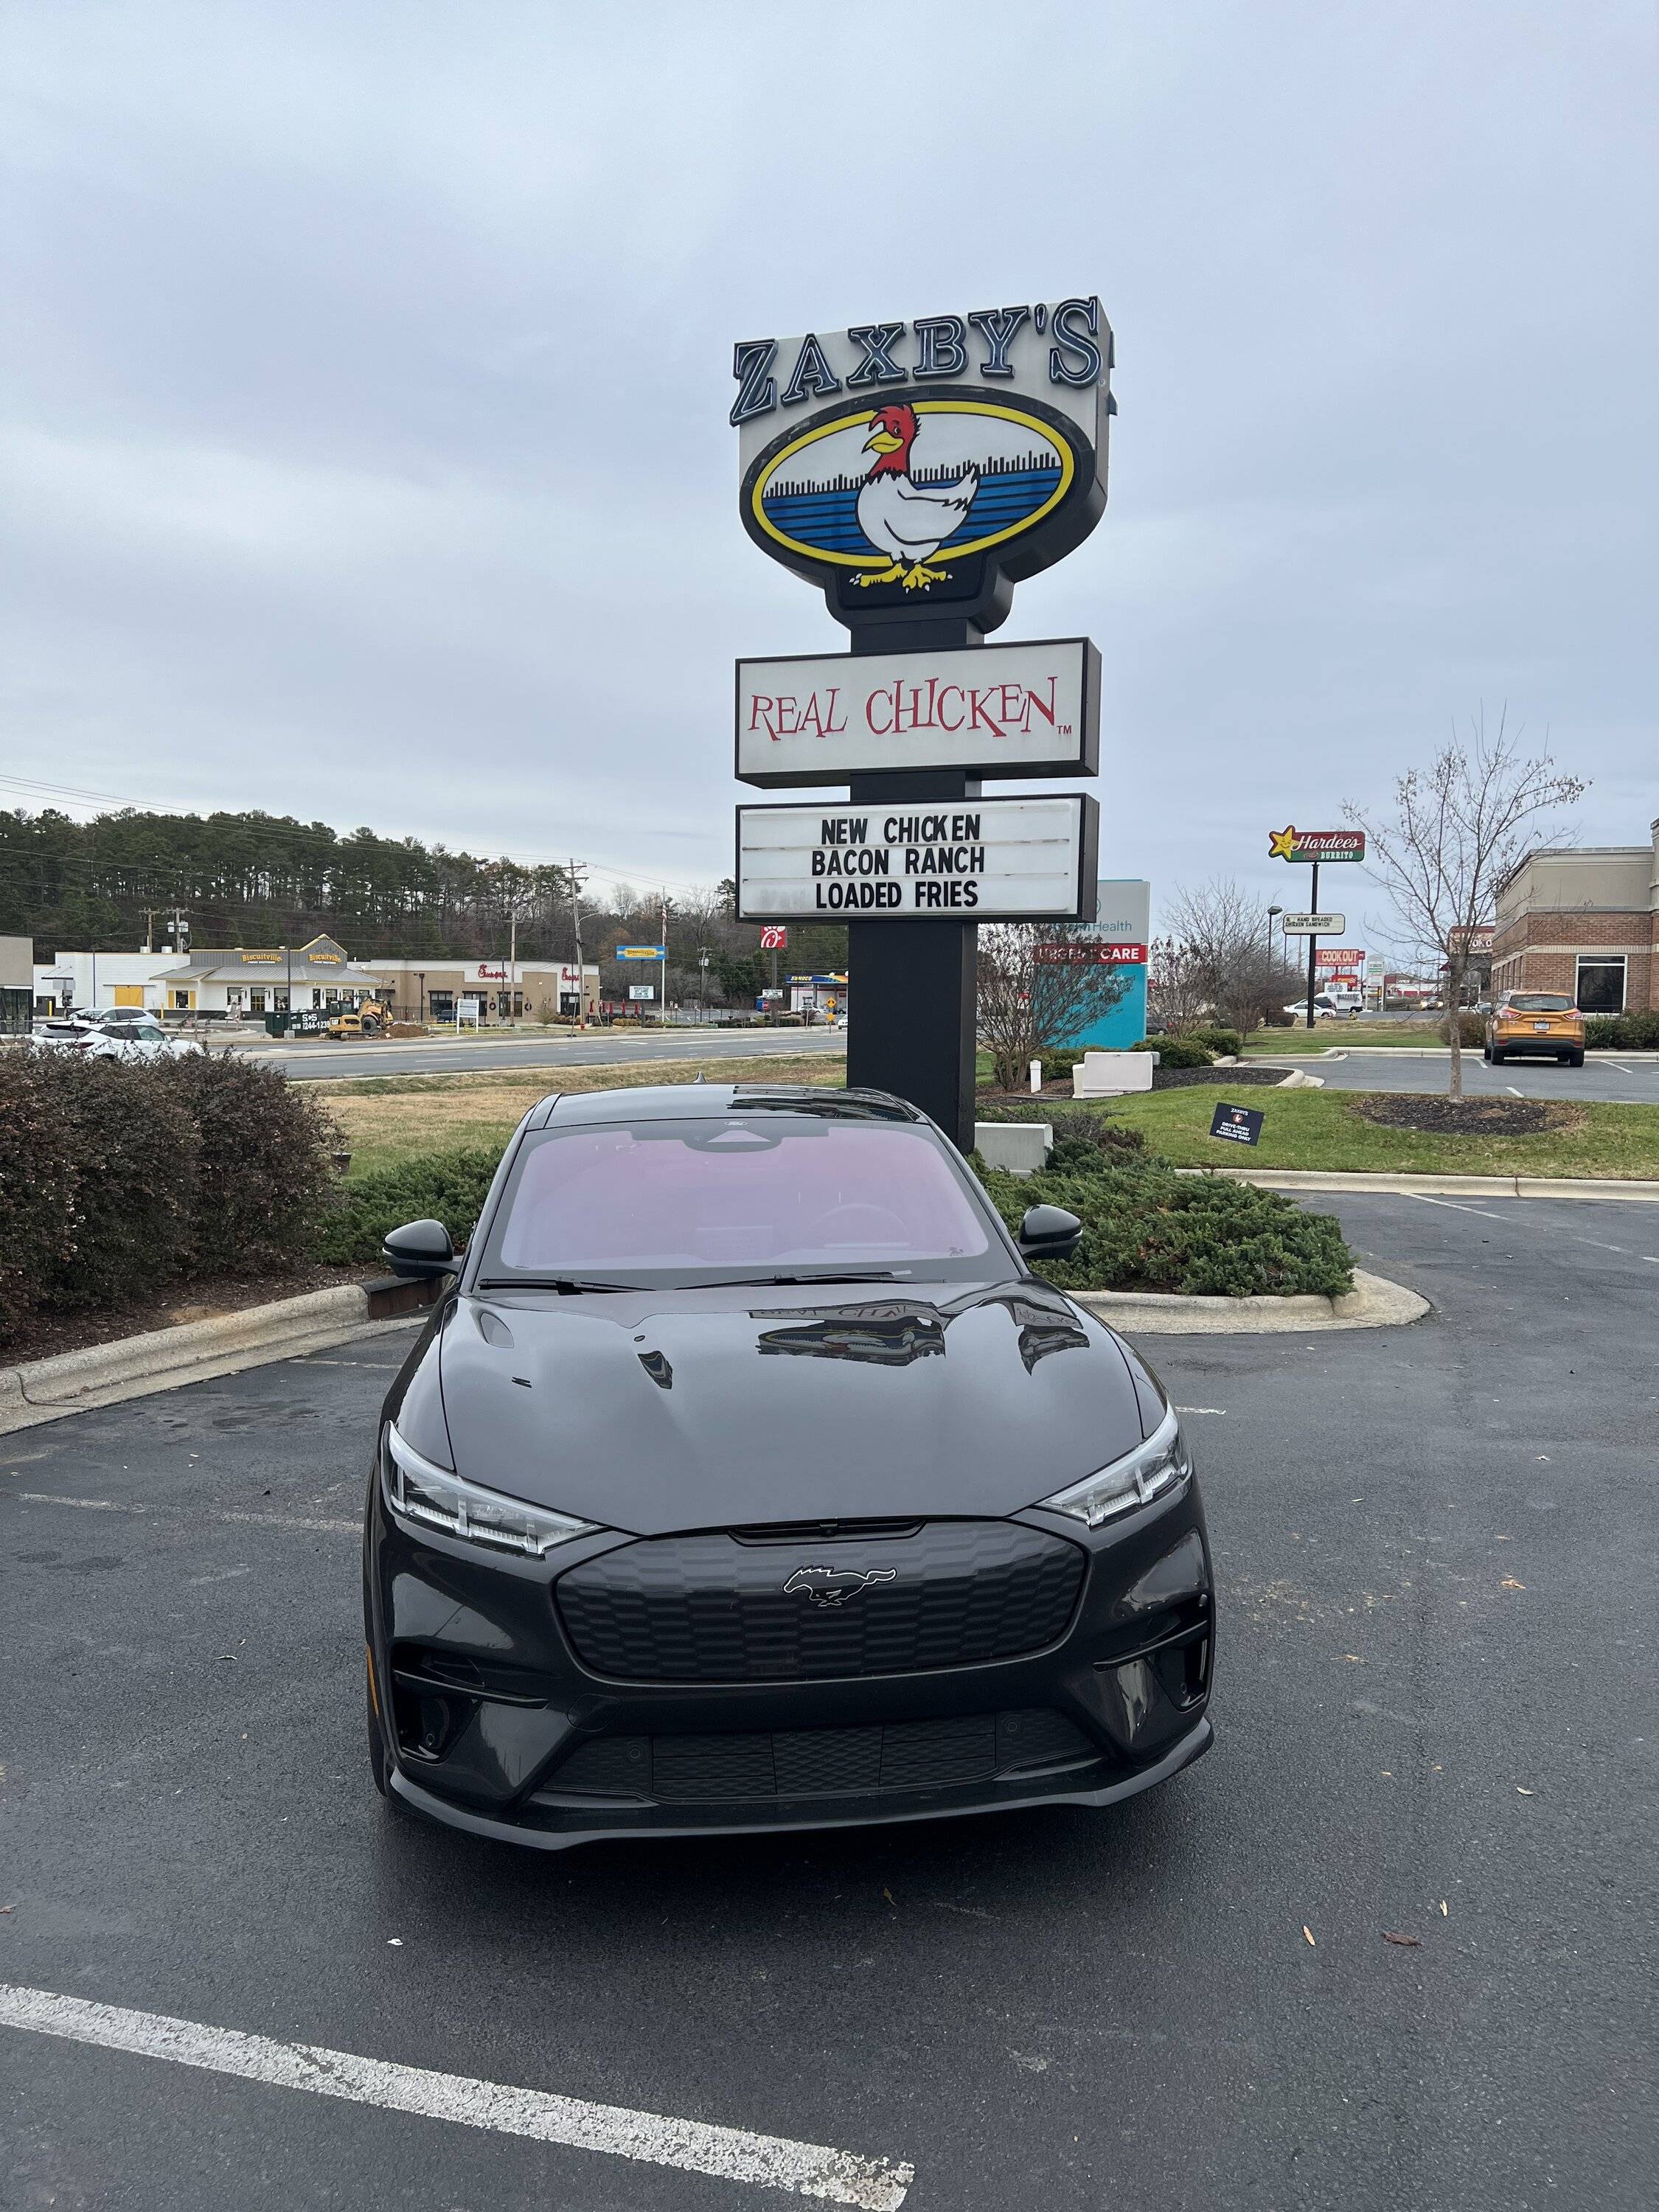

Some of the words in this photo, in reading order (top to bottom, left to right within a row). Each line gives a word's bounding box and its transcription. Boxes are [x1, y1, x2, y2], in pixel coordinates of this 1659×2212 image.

[729, 296, 1104, 427] ZAXBY'S
[747, 688, 849, 741] REAL
[866, 676, 1058, 738] CHICKEN
[821, 818, 868, 845] NEW
[883, 814, 981, 844] CHICKEN
[1290, 834, 1362, 851] Hardee's
[812, 849, 889, 877] BACON
[905, 846, 985, 875] RANCH
[1320, 851, 1354, 860] BURRITO
[815, 881, 902, 909] LOADED
[915, 880, 978, 908] FRIES
[1093, 919, 1133, 932] Health
[242, 953, 283, 962] Biscuitville
[1100, 947, 1140, 960] CARE
[1321, 950, 1342, 962] COOK
[1343, 950, 1358, 962] OUT
[1222, 1121, 1251, 1132] DRIVE-THRU
[1232, 1128, 1249, 1136] AHEAD
[1216, 1130, 1237, 1138] PARKING
